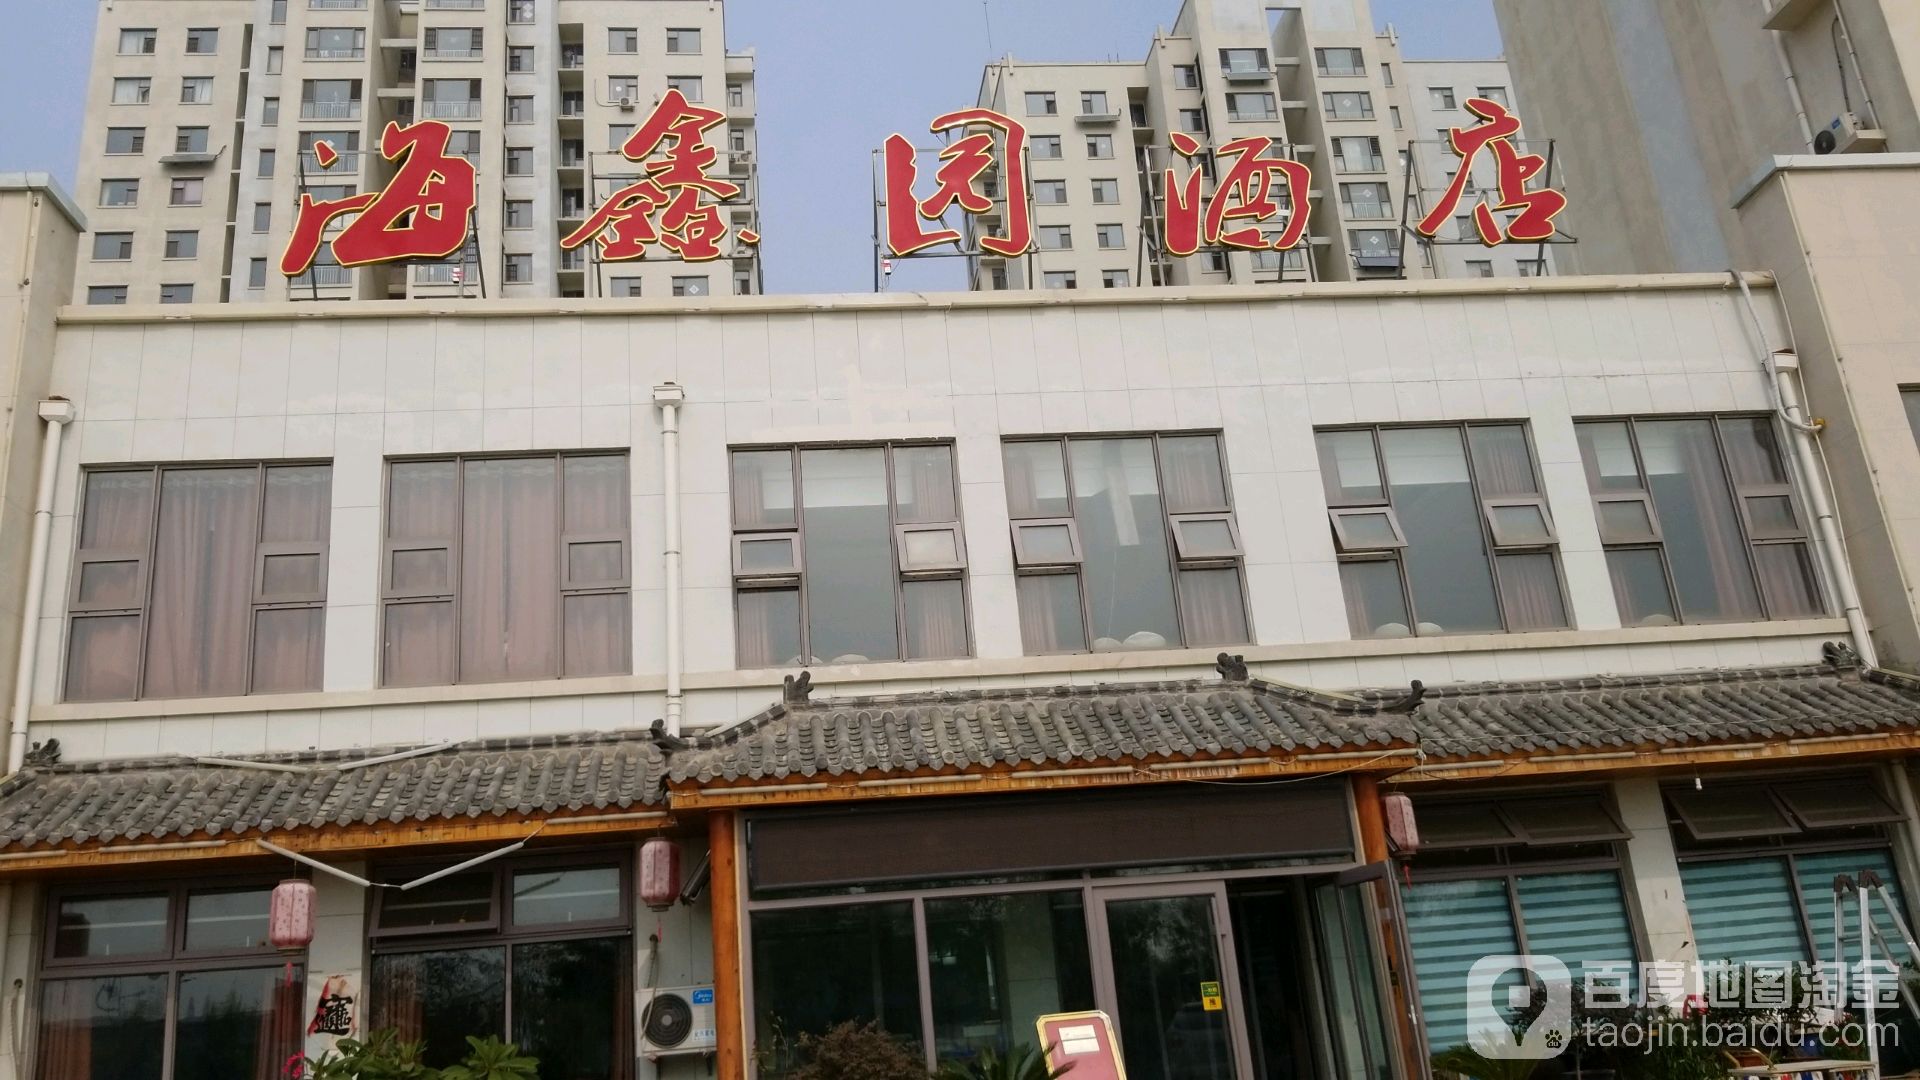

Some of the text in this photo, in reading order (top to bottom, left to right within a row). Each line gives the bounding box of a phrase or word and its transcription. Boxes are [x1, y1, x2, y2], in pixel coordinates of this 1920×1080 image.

[281, 89, 1567, 276] 海鑫园酒店
